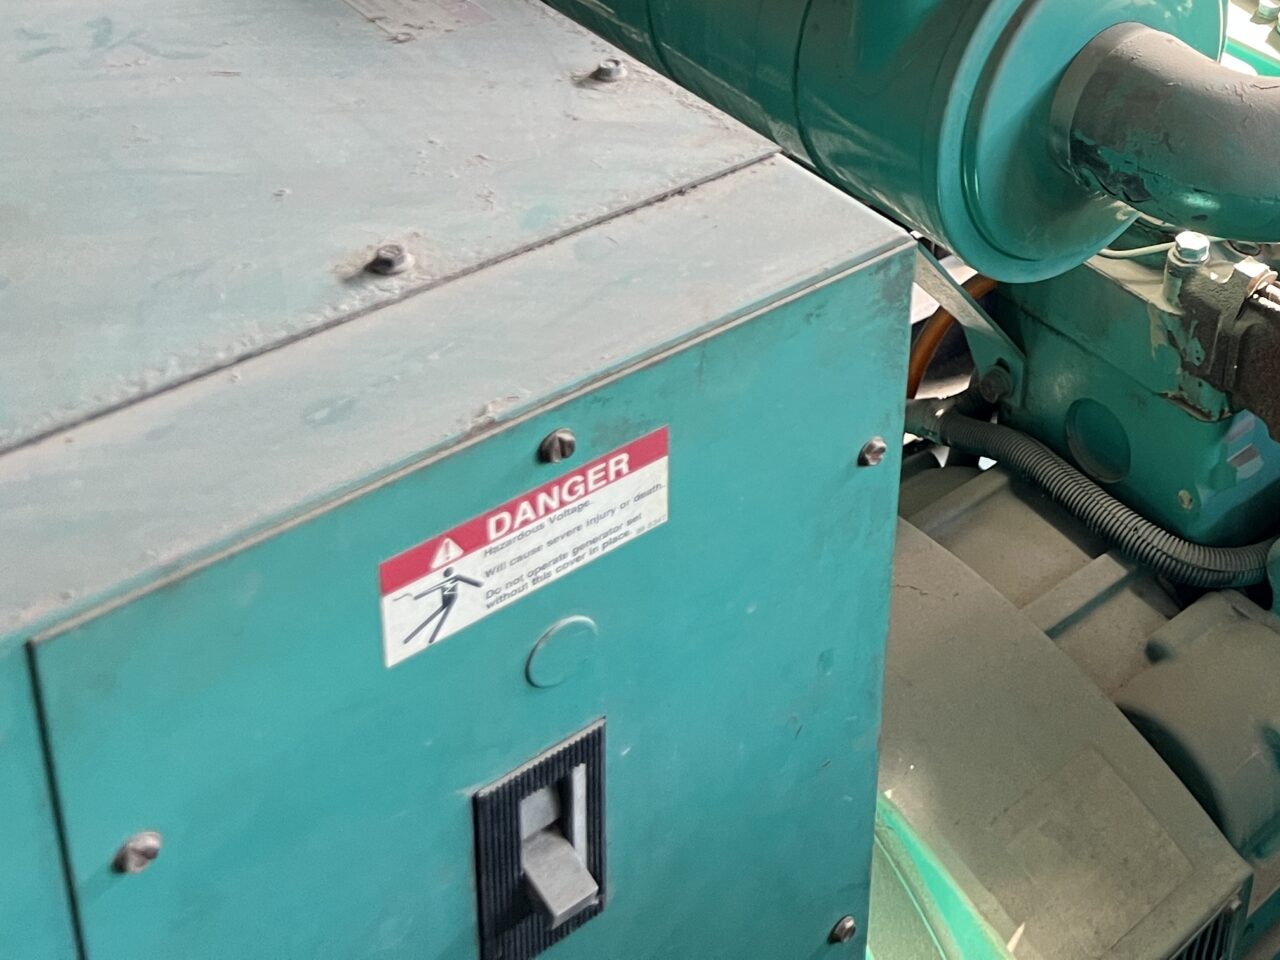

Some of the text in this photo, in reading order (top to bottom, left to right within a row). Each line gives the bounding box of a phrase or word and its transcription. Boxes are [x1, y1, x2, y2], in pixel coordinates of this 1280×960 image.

[486, 452, 631, 542] DANGER
[484, 561, 507, 579] Will
[509, 545, 544, 567] cause
[546, 524, 583, 549] severe
[585, 506, 616, 528] injury
[619, 498, 631, 510] or
[484, 522, 545, 558] Hazardous
[485, 586, 502, 600] Do
[504, 574, 524, 591] not
[526, 552, 568, 580] operate
[571, 524, 624, 557] generator
[625, 512, 642, 528] set
[485, 583, 529, 610] without
[531, 569, 552, 586] this
[554, 553, 587, 575] cover
[589, 544, 600, 556] in
